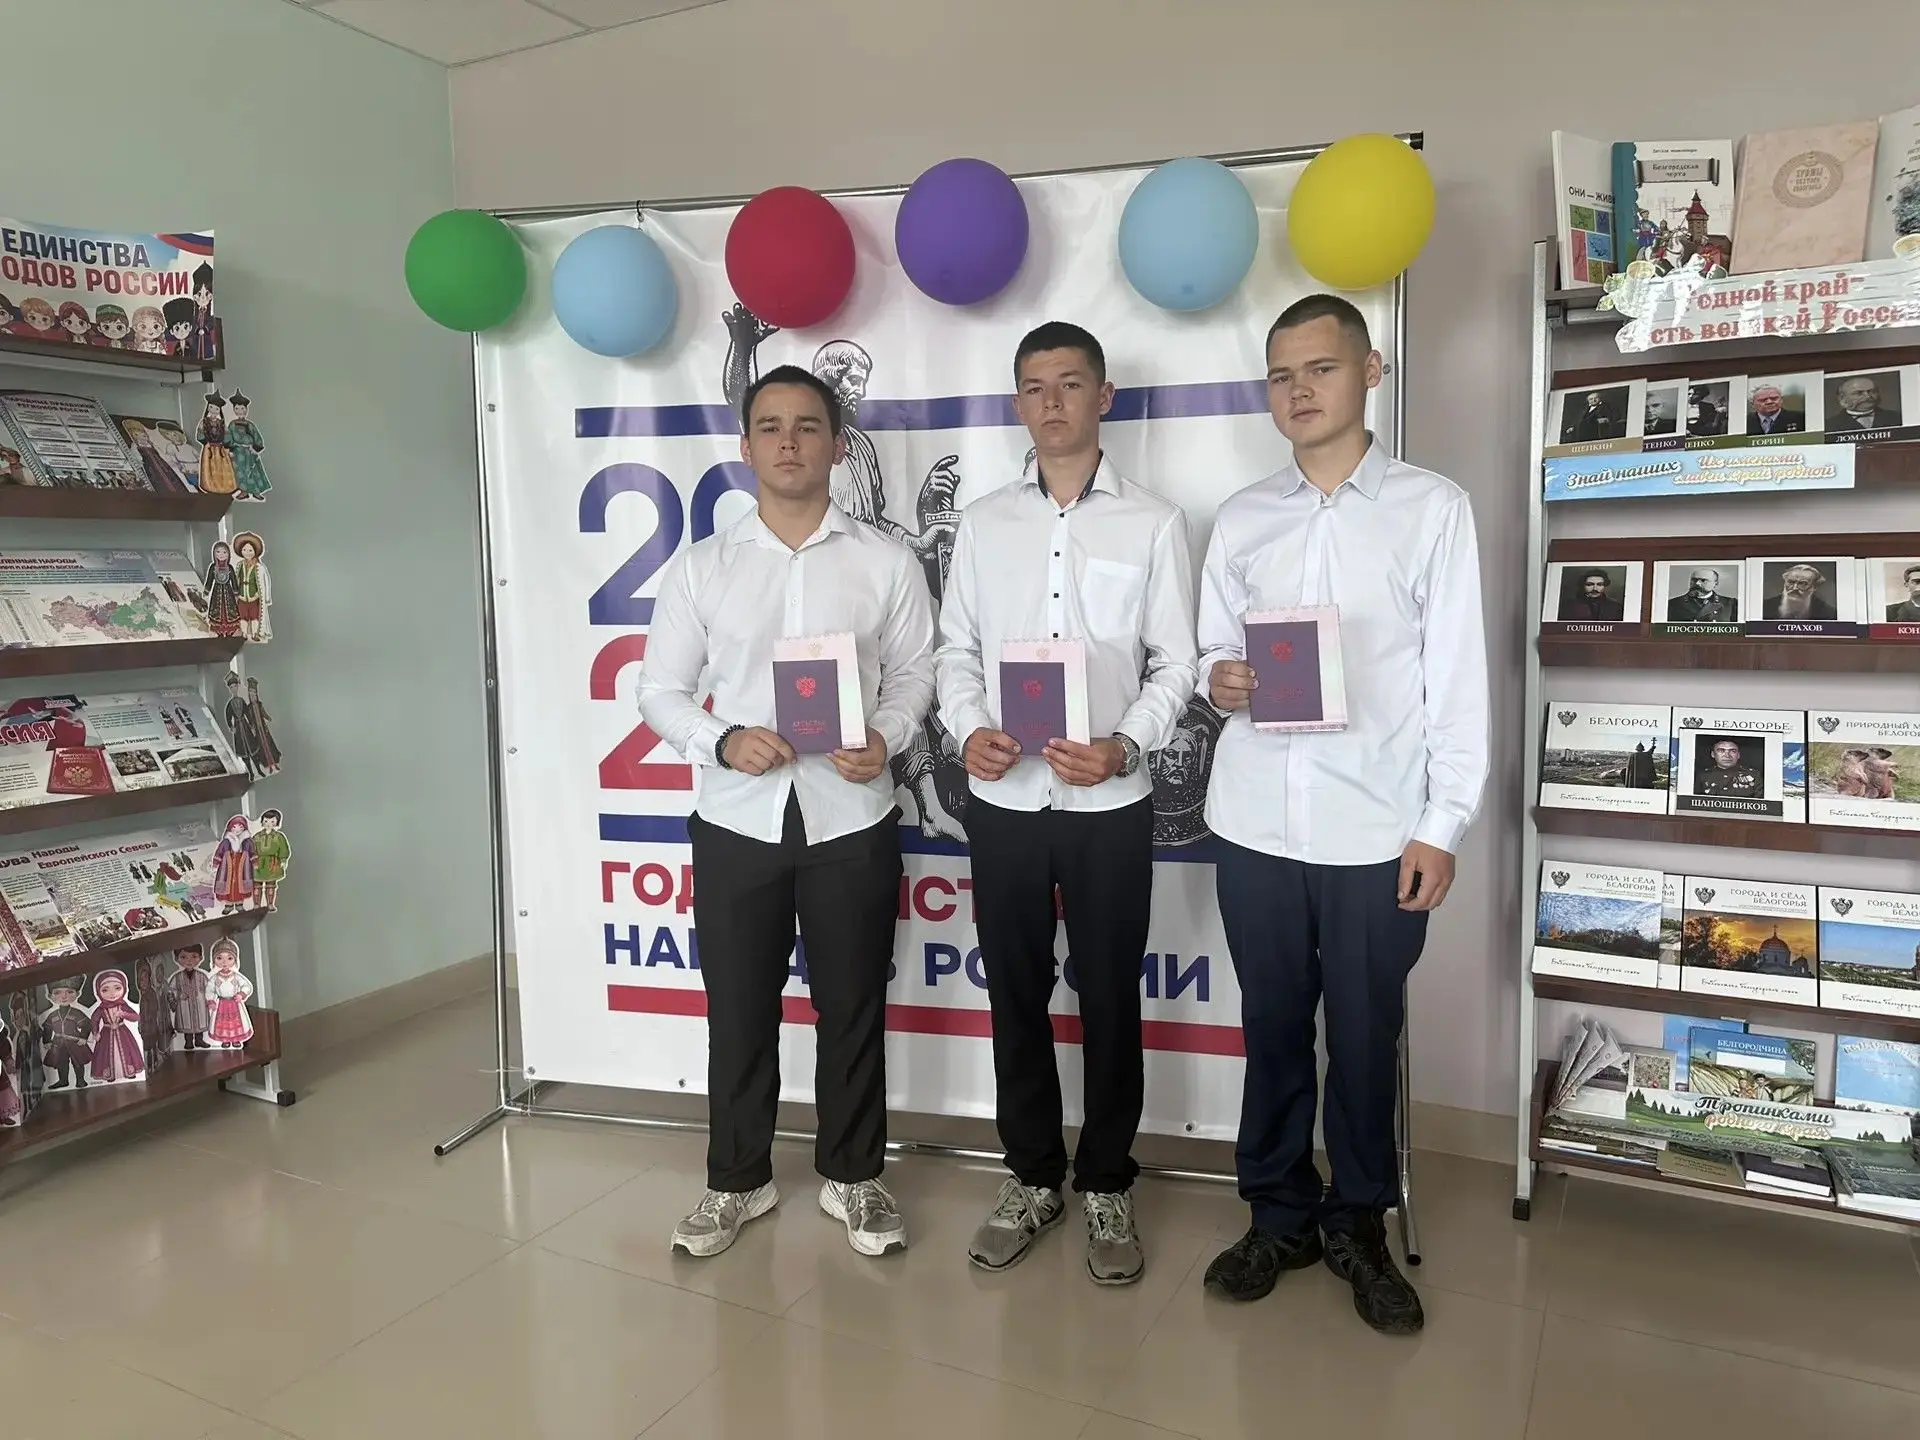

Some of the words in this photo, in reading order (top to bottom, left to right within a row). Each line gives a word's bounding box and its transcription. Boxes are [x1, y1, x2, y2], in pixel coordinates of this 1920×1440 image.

[1568, 186, 1586, 198] ОНИ
[1, 227, 151, 268] ЕДИНСТВА
[85, 268, 188, 296] РОССИИ
[1752, 437, 1785, 446] ГОРИН
[1836, 431, 1891, 442] ЛОМАКИН
[1572, 442, 1613, 453] ЩЕПКИН
[1567, 467, 1612, 487] Знай
[1615, 460, 1679, 479] наших
[1566, 624, 1614, 633] ГОЛИЦЫН
[1666, 625, 1739, 634] ПРОСКУРЯКОВ
[1777, 622, 1823, 632] СТРАХОВ
[1898, 627, 1920, 635] КОН
[1589, 716, 1658, 728] БЕЛГОРОД
[1713, 719, 1791, 731] БЕЛОГОРЬЕ
[1846, 720, 1910, 730] ПРИРОДНЫЙ
[1691, 799, 1767, 811] ШАПОШНИКОВ
[32, 844, 80, 859] Народы
[37, 850, 118, 870] Европейского
[118, 841, 159, 854] Севера
[1585, 873, 1620, 881] ГОРОДА
[1606, 882, 1657, 891] БЕЛОГОРЬЯ
[1730, 889, 1766, 897] ГОРОДА
[1781, 890, 1806, 900] СЁЛА
[1753, 897, 1808, 907] БЕЛОГОРЬЯ
[1867, 899, 1906, 909] ГОРОДА
[1892, 909, 1920, 917] БЕЛО
[1717, 1039, 1787, 1055] БЕЛГОРОДЧИНА
[1695, 1096, 1831, 1124] Тропинками
